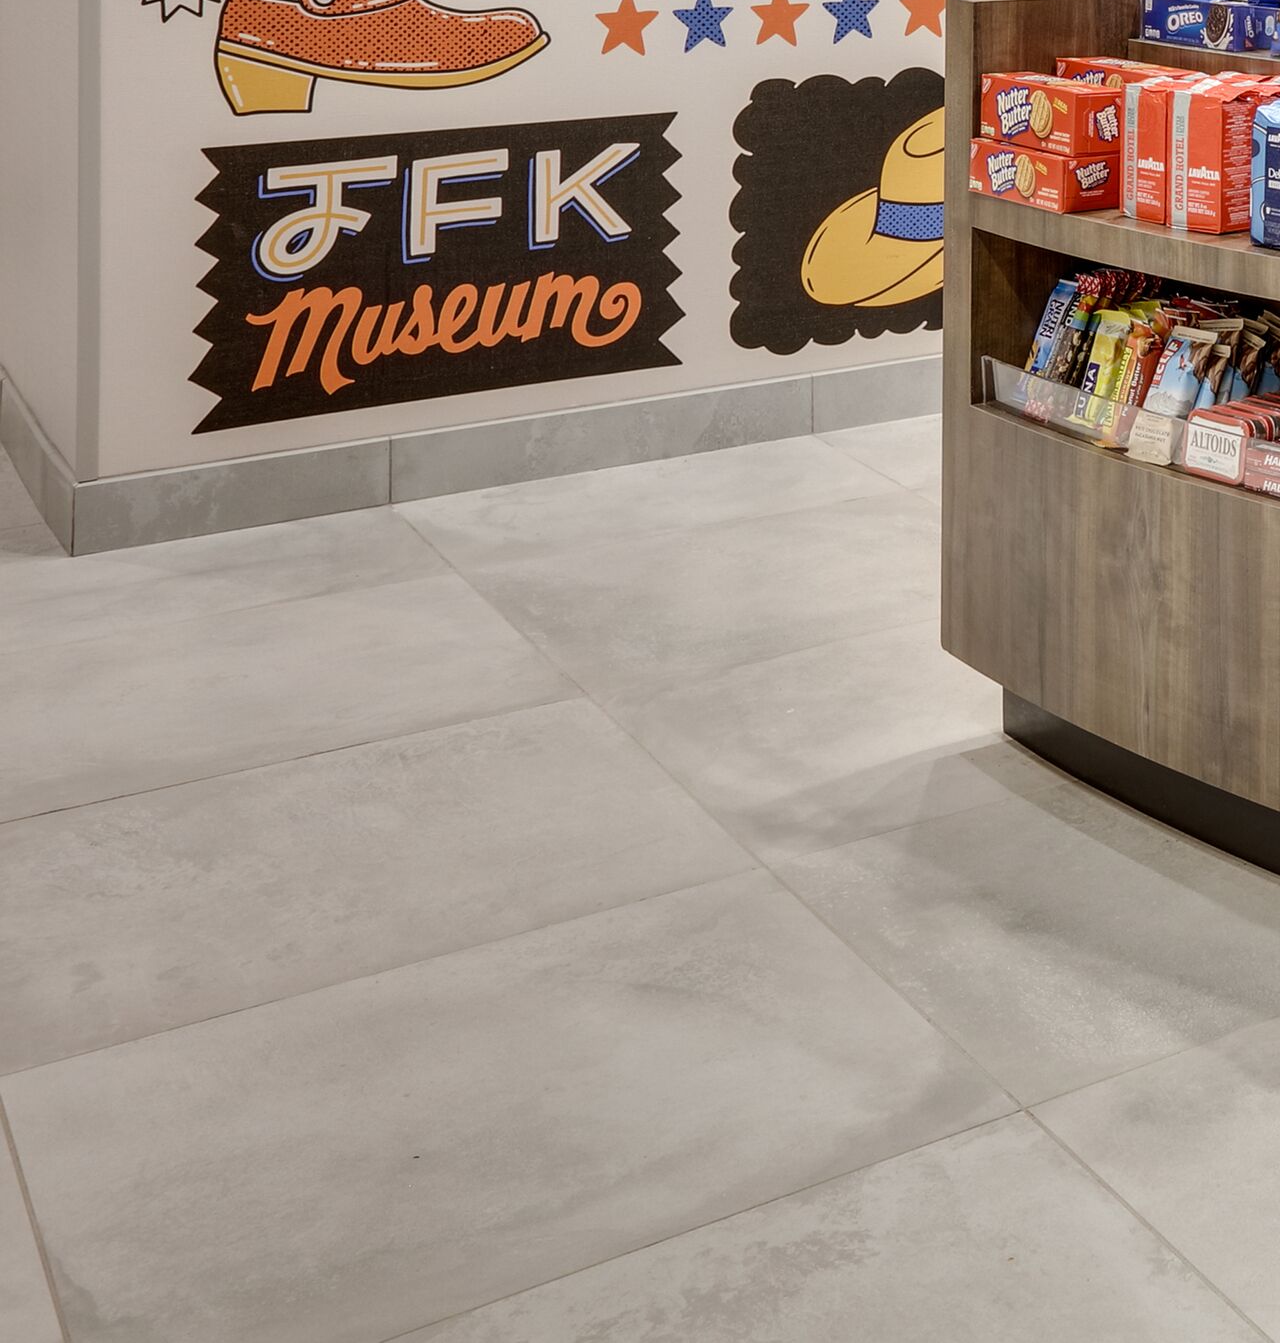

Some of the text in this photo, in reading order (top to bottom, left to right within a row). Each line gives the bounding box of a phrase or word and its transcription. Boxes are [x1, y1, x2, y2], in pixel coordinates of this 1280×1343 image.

[1166, 11, 1204, 32] OREO
[997, 88, 1029, 116] Nutter
[1000, 104, 1032, 135] Butter
[1096, 111, 1113, 142] Butter
[1103, 104, 1120, 137] Nutter
[1127, 128, 1136, 161] HOTEL
[1175, 137, 1186, 170] HOTEL
[988, 152, 1015, 176] Nutter
[990, 166, 1017, 192] Butter
[1076, 161, 1107, 180] Nutter
[1080, 168, 1110, 190] Butter
[1137, 157, 1166, 172] LAVAZZA
[1188, 166, 1221, 181] LAVAZZA
[1126, 165, 1135, 201] GRAND
[1175, 174, 1184, 211] GRAND
[251, 142, 642, 283] JFK
[246, 273, 641, 394] Museum
[1045, 300, 1065, 339] NUTRI
[1132, 362, 1142, 387] Butter
[1077, 368, 1098, 417] LUNA
[1190, 430, 1238, 457] ALTOIDS
